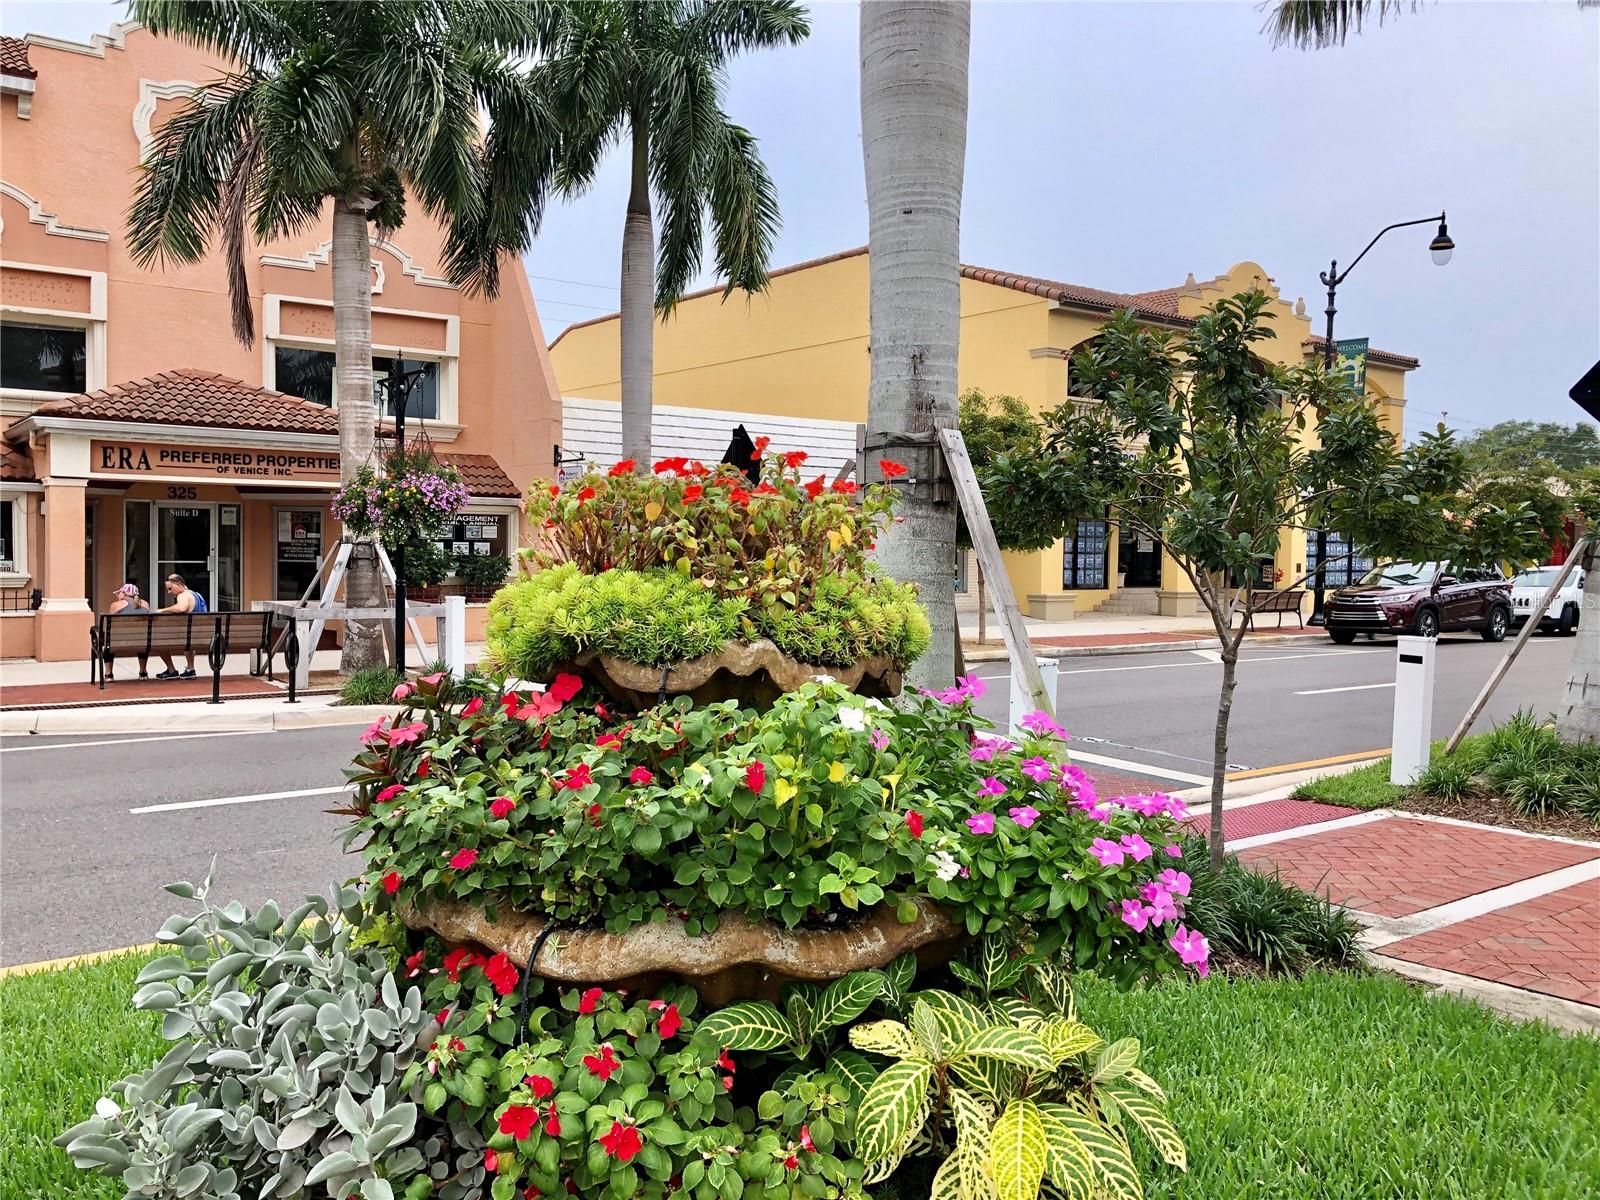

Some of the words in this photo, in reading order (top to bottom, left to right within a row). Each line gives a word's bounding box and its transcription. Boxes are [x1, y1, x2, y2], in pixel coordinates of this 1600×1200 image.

[1337, 344, 1367, 352] WELCOME
[101, 446, 152, 470] ERA
[160, 450, 251, 466] PREFERRED
[256, 454, 340, 470] PROPERTIE
[216, 466, 230, 474] OF
[234, 467, 269, 475] VENICE
[274, 468, 293, 476] INC.
[167, 486, 197, 499] 325
[169, 508, 192, 517] Suite
[193, 509, 199, 517] D
